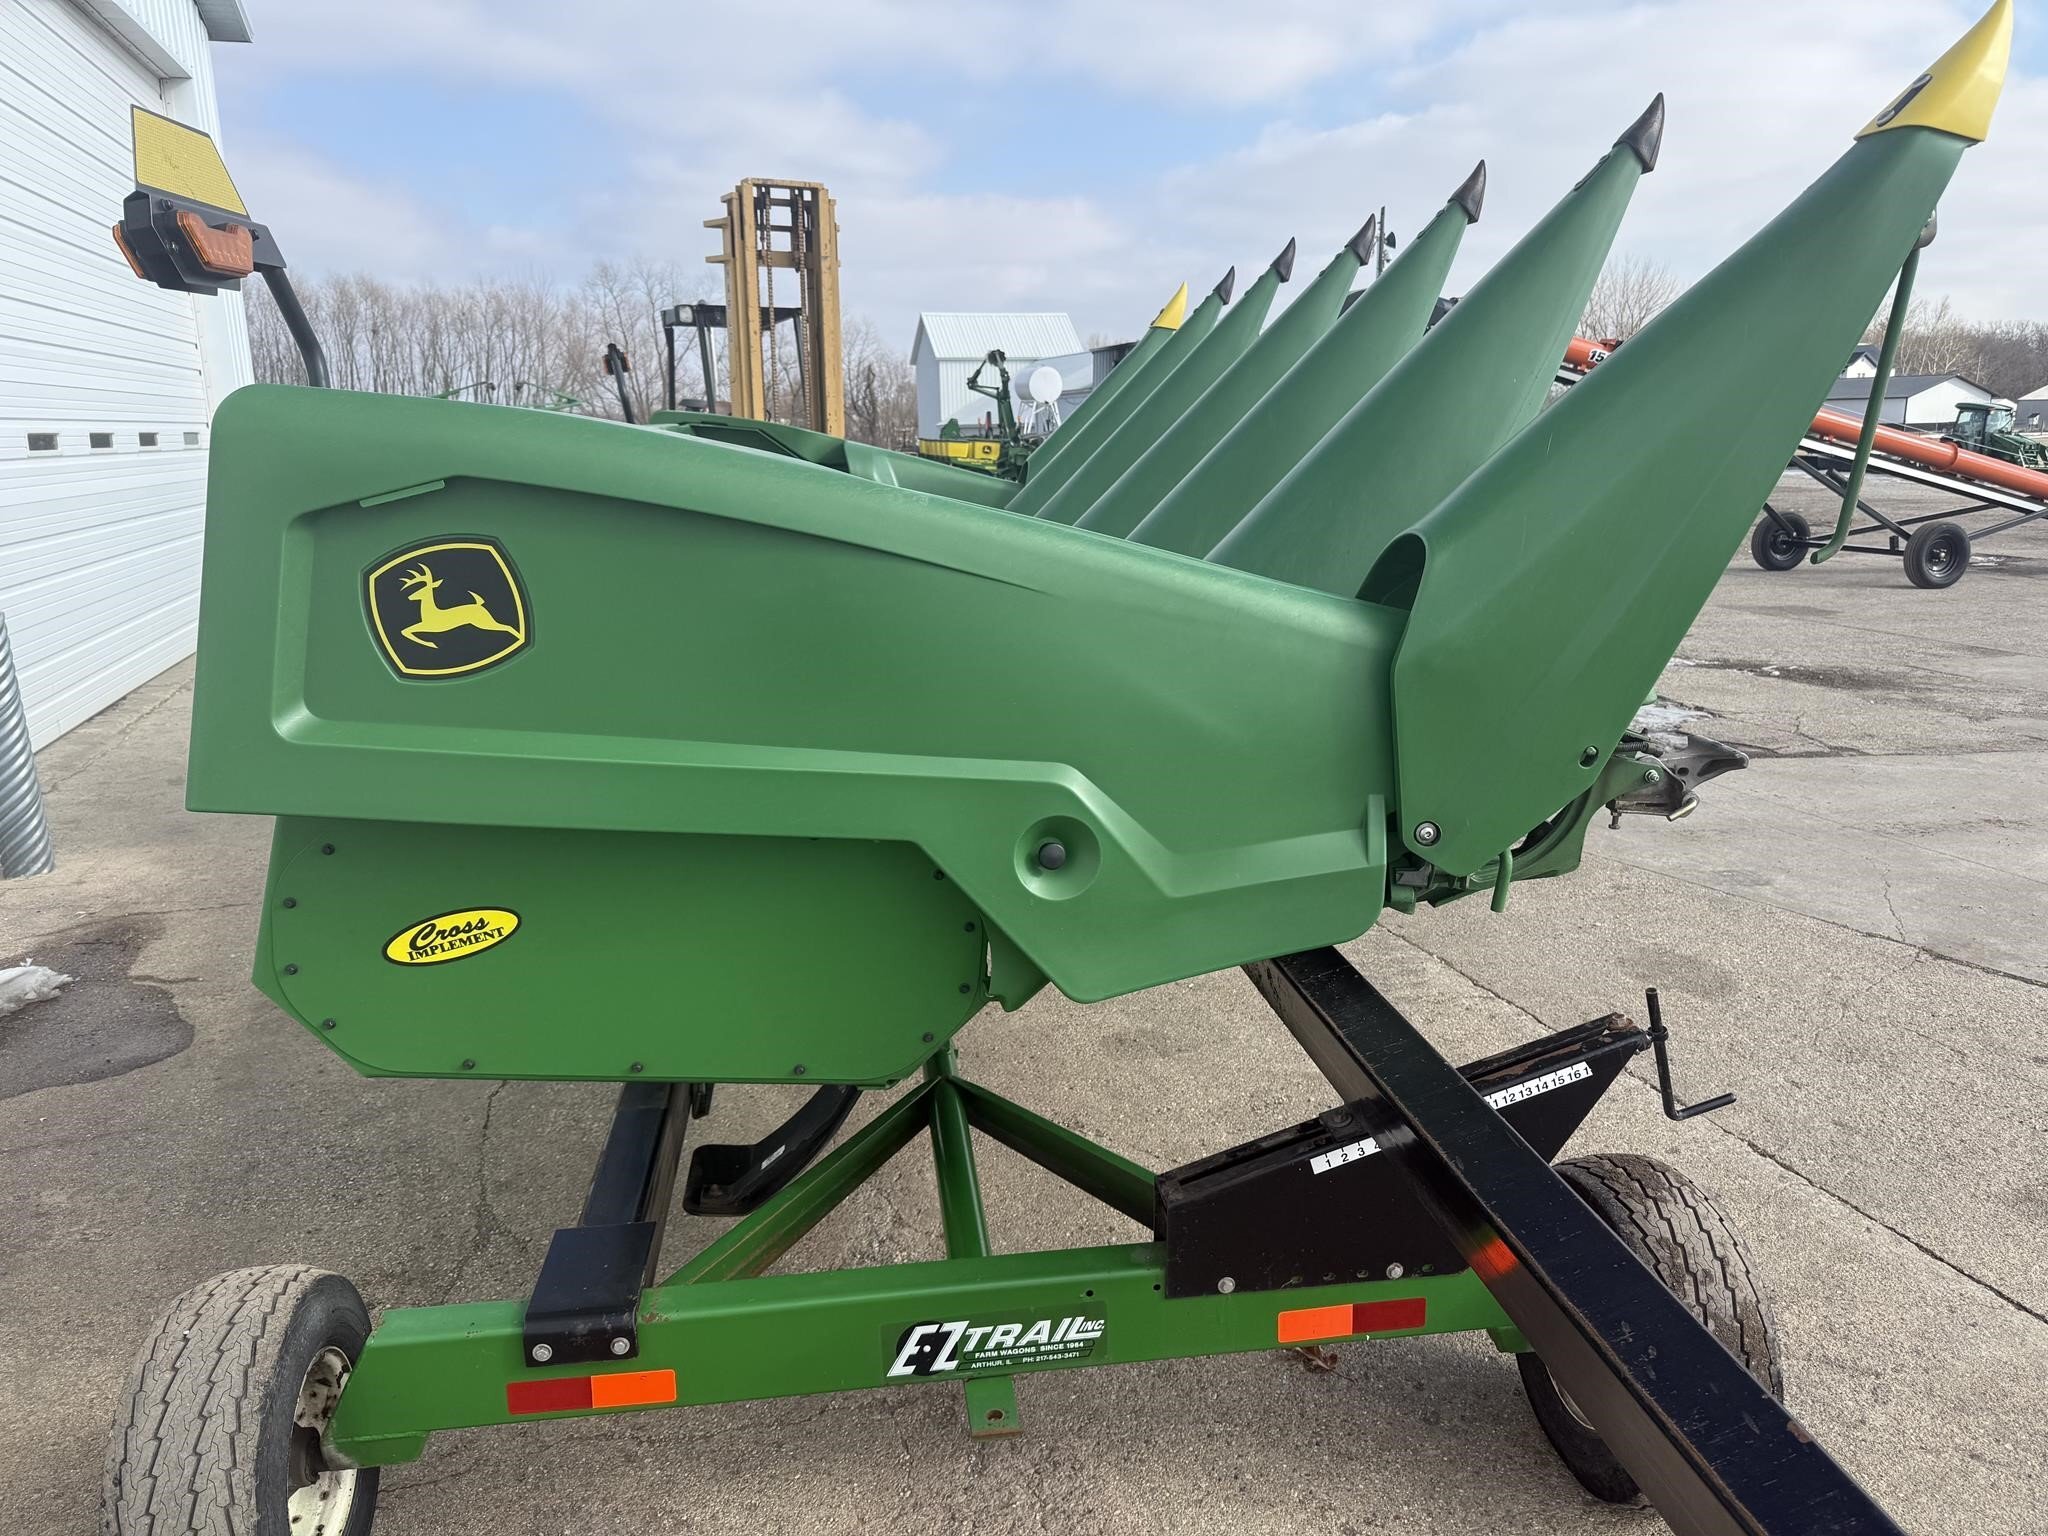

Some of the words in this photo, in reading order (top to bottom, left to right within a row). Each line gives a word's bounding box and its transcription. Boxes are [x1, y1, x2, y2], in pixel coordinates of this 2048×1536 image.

[407, 926, 504, 961] IMPLEMENT
[409, 917, 489, 951] Cross
[1502, 1092, 1517, 1104] 12
[1519, 1087, 1533, 1099] 13
[1534, 1081, 1549, 1093] 14
[1551, 1075, 1565, 1087] 15
[1567, 1069, 1582, 1081] 16
[1325, 1159, 1332, 1168] 1
[1340, 1152, 1350, 1163] 2
[1357, 1147, 1366, 1156] 3
[963, 1316, 1103, 1352] TRAIL
[1079, 1319, 1106, 1332] INC.
[975, 1350, 998, 1359] FARM
[1000, 1346, 1036, 1356] WAGONS
[1040, 1342, 1065, 1352] SINCE
